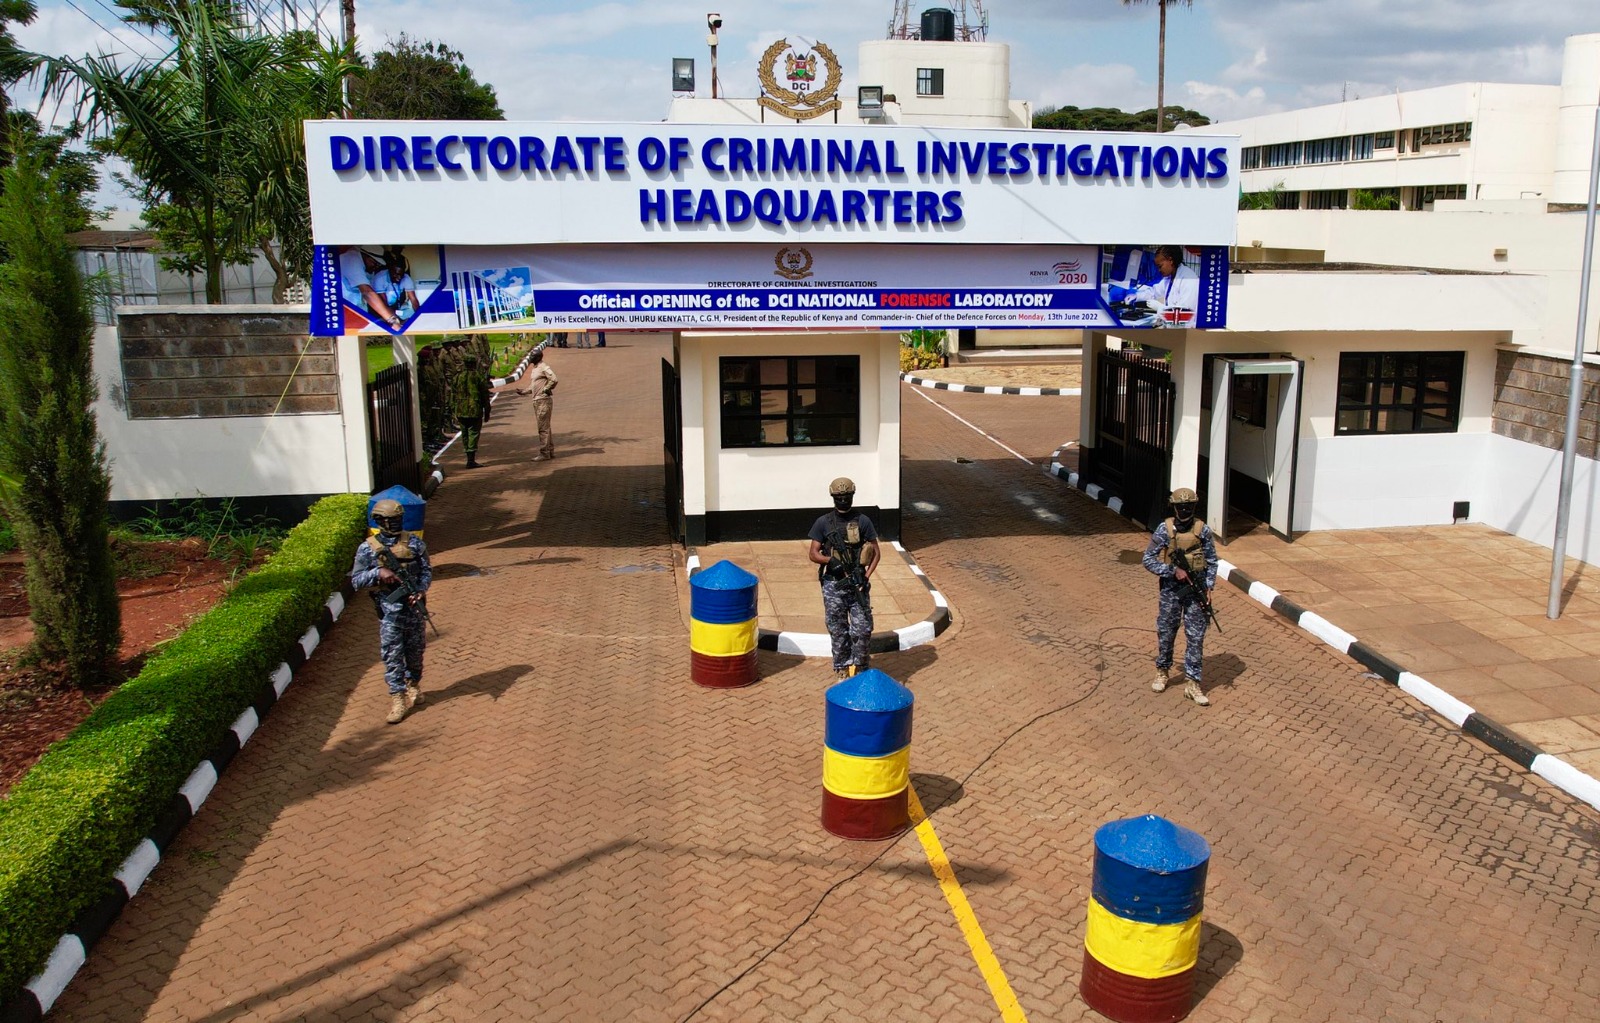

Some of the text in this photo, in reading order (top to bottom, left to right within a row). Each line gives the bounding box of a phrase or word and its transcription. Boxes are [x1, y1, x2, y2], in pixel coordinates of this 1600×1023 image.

[792, 82, 810, 91] DCI
[762, 99, 790, 116] NATIONAL
[815, 101, 838, 115] SERVICE
[329, 135, 1228, 179] DIRECTORATE OF CRIMINAL INVESTIGATIONS
[639, 188, 963, 226] HEADQUARTERS
[814, 280, 878, 288] INVESTIGATIONS
[1058, 273, 1088, 284] 2030
[578, 293, 1053, 309] Official OPENING of the DCI NATIONAL FORENSIC LABORATORY
[543, 315, 553, 325] By
[554, 315, 567, 324] His
[568, 315, 607, 325] Excellency
[608, 315, 628, 323] HON.
[628, 315, 656, 323] UHURU
[723, 314, 758, 323] President
[758, 314, 767, 322] of
[767, 314, 780, 322] the
[781, 313, 811, 323] Republic
[812, 313, 821, 321] of
[822, 313, 844, 323] Kenya
[844, 313, 858, 321] and
[915, 313, 934, 321] Chief
[934, 313, 943, 321] of
[943, 313, 955, 321] the
[956, 313, 984, 321] Defence
[984, 313, 1007, 321] Forces
[1018, 313, 1046, 322] Monday,
[1047, 313, 1063, 321] 13th
[1064, 313, 1080, 321] June
[1081, 313, 1098, 321] 2022
